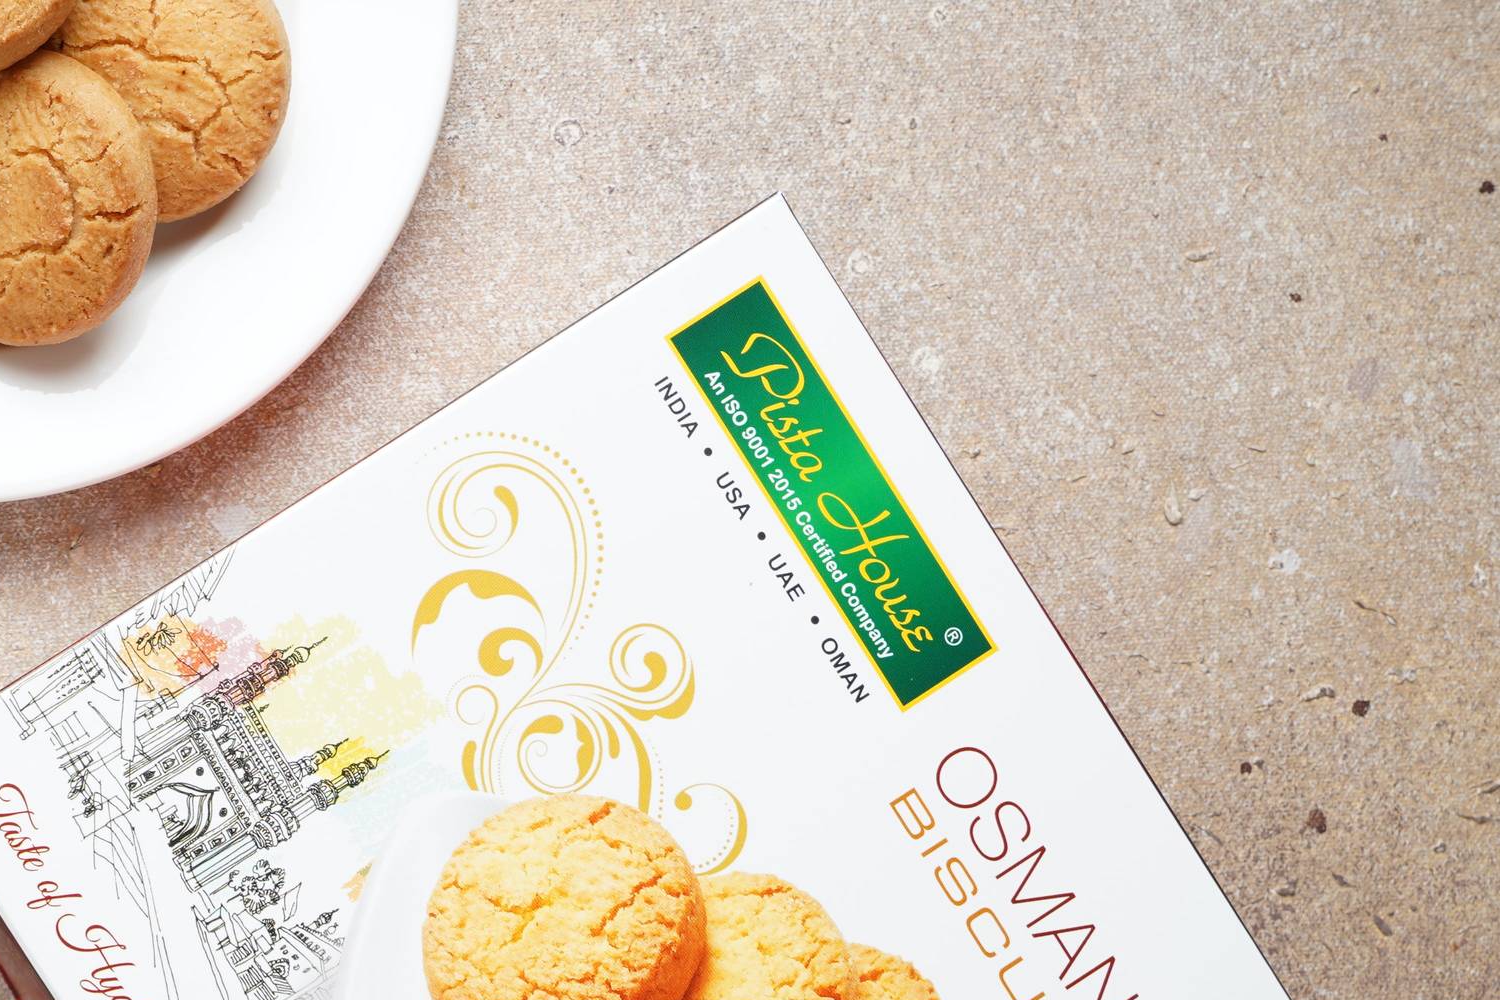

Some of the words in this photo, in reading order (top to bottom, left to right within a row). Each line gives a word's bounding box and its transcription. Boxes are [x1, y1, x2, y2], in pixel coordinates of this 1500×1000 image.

[654, 375, 700, 439] INDIA
[716, 471, 752, 521] USA
[768, 553, 806, 602] UAE
[820, 637, 871, 704] OMAN
[703, 371, 736, 396] An
[720, 393, 748, 427] ISO
[741, 426, 775, 468] 9001
[767, 468, 803, 511] 2015
[795, 511, 848, 583] Certified
[841, 582, 894, 659] Company
[720, 332, 823, 483] Pista
[817, 492, 934, 653] House
[27, 881, 83, 909] of
